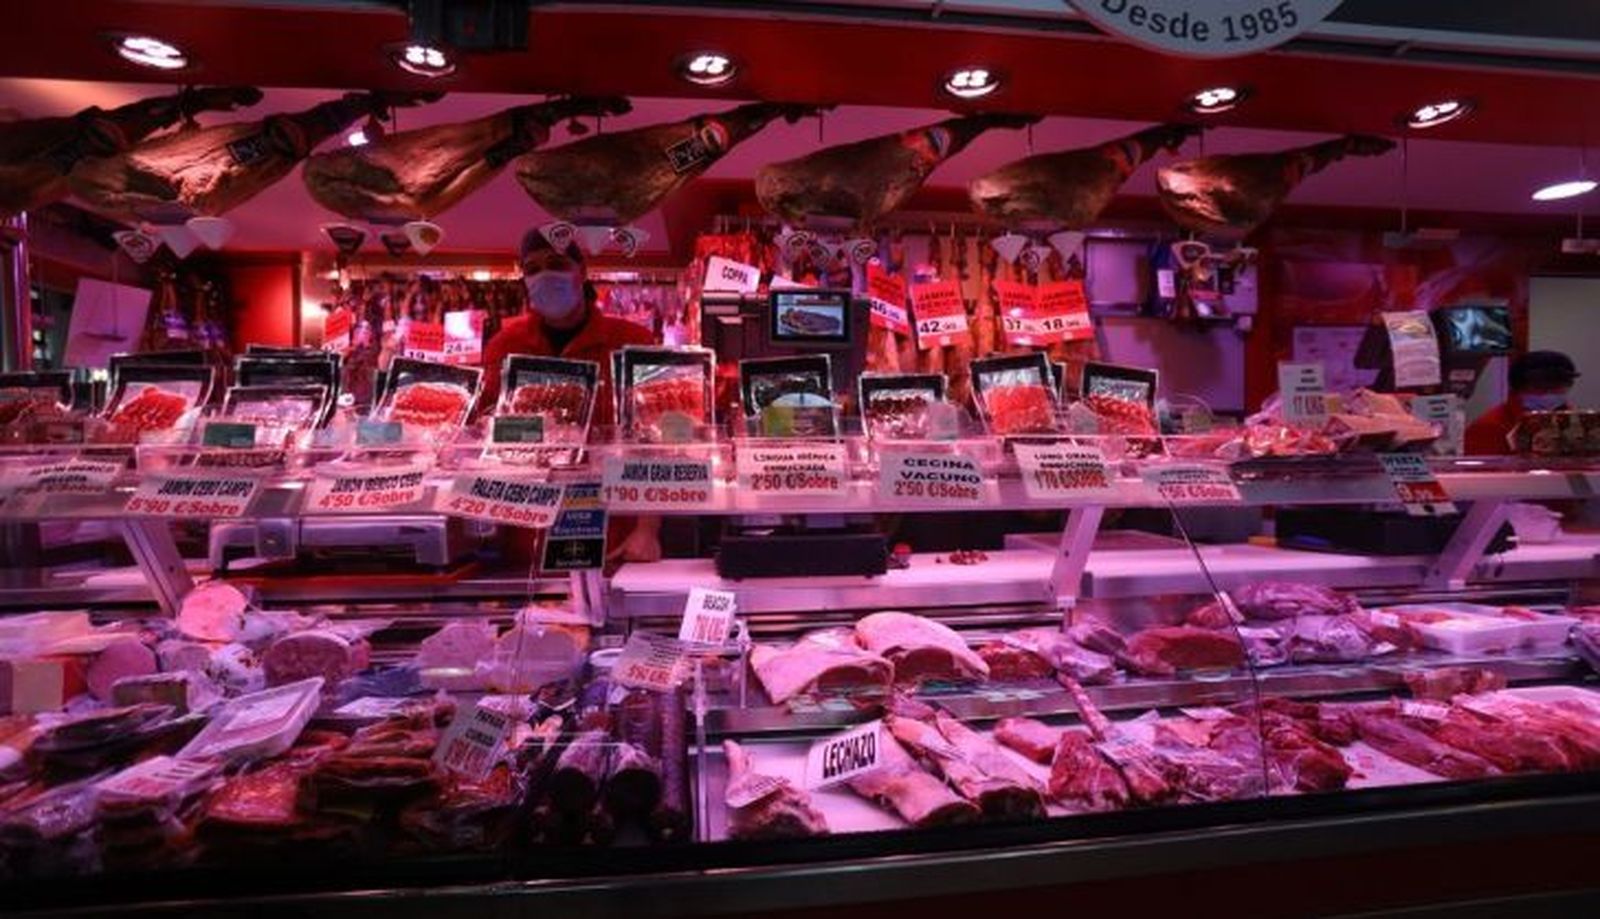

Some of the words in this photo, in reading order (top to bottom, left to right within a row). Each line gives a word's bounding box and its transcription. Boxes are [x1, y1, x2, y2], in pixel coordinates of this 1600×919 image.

[1101, 0, 1210, 42] Desde
[1221, 1, 1299, 42] 1985
[903, 458, 975, 470] CECINA
[751, 473, 782, 490] 2'50
[900, 471, 981, 485] VACUNO
[604, 486, 639, 502] 1'90
[644, 487, 707, 502] €/Sobre
[893, 481, 925, 497] 2'50
[128, 498, 170, 513] 5'90
[174, 500, 239, 515] €/Sobre
[823, 731, 876, 779] LECHAZO
